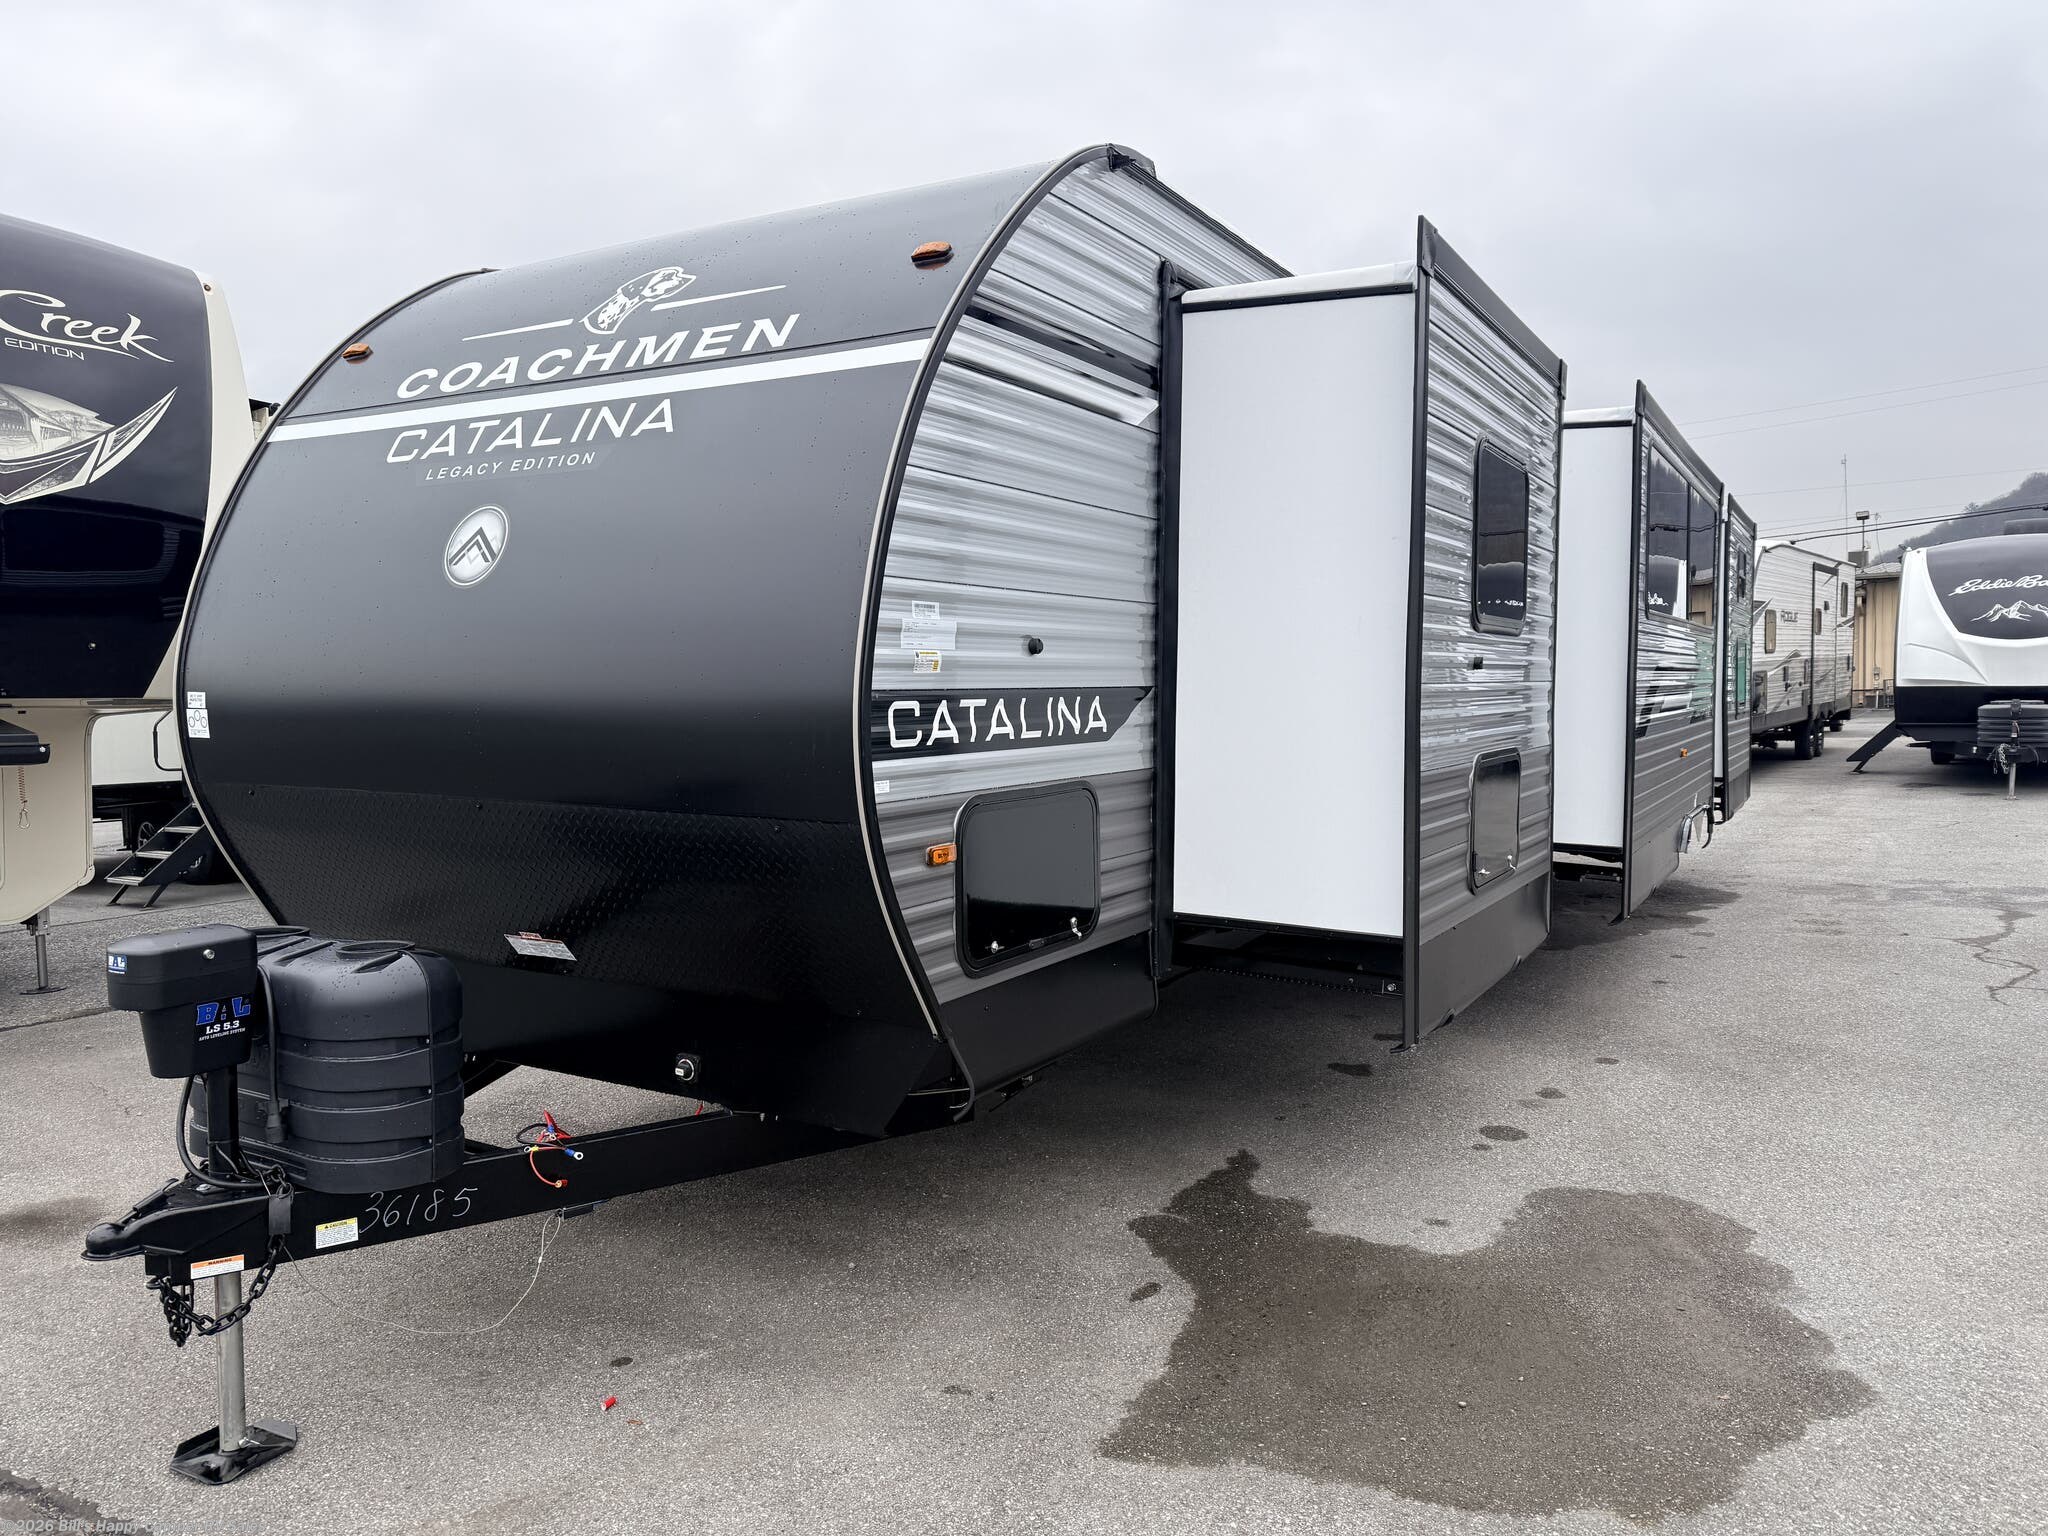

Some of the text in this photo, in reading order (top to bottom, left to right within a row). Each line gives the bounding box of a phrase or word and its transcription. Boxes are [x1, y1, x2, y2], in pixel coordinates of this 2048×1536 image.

[0, 289, 175, 363] Creek
[4, 337, 85, 361] EDITION
[396, 313, 800, 399] COACHMEN
[386, 398, 674, 464] CATALINA
[424, 451, 596, 481] LEGACY EDITION
[1948, 578, 2014, 595] Eddie
[887, 695, 1108, 749] CATALINA
[195, 996, 251, 1026] BAL
[205, 1019, 240, 1035] LS 5.3
[359, 1187, 479, 1234] 36185
